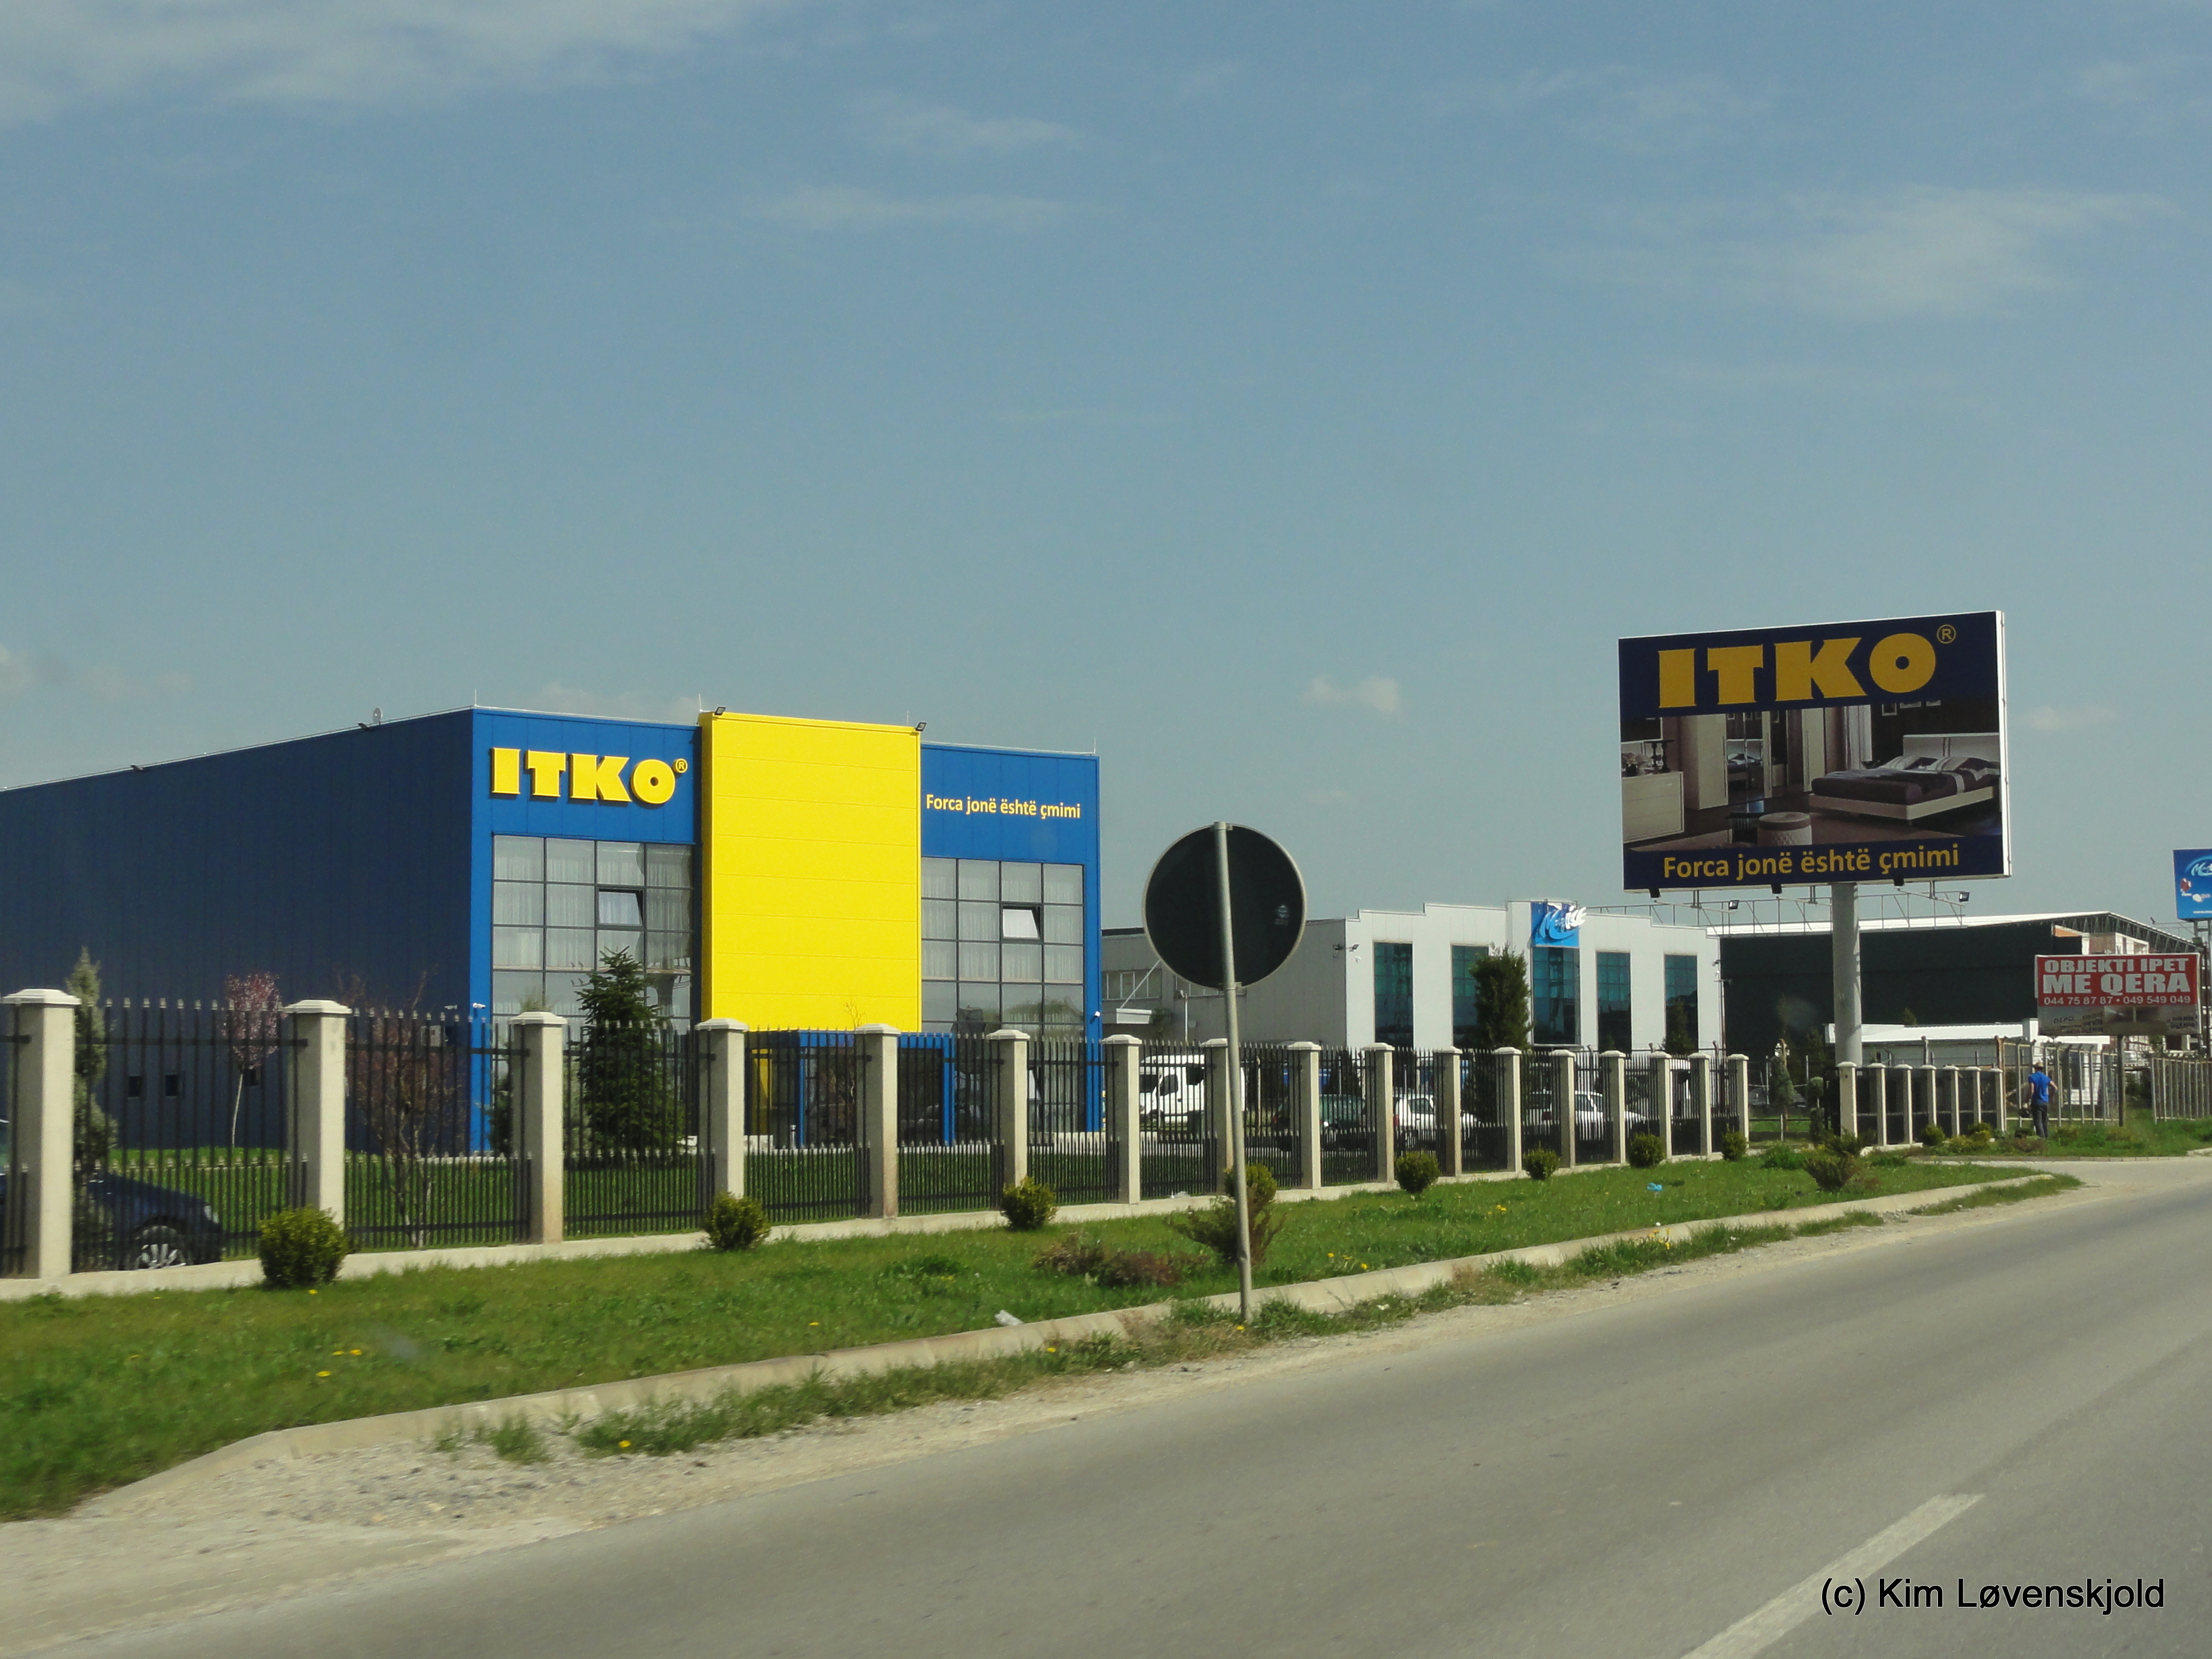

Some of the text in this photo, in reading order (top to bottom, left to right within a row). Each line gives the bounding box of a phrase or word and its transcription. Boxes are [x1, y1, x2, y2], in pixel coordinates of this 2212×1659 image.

[926, 794, 1081, 819] Forca jonë është çmimi
[1663, 843, 1959, 880] Forca jonë është çmimi
[2044, 957, 2190, 973] OBJEKTI IPET
[2043, 973, 2191, 996] ME QERA
[2083, 996, 2096, 1005] 87
[2123, 996, 2143, 1004] 049
